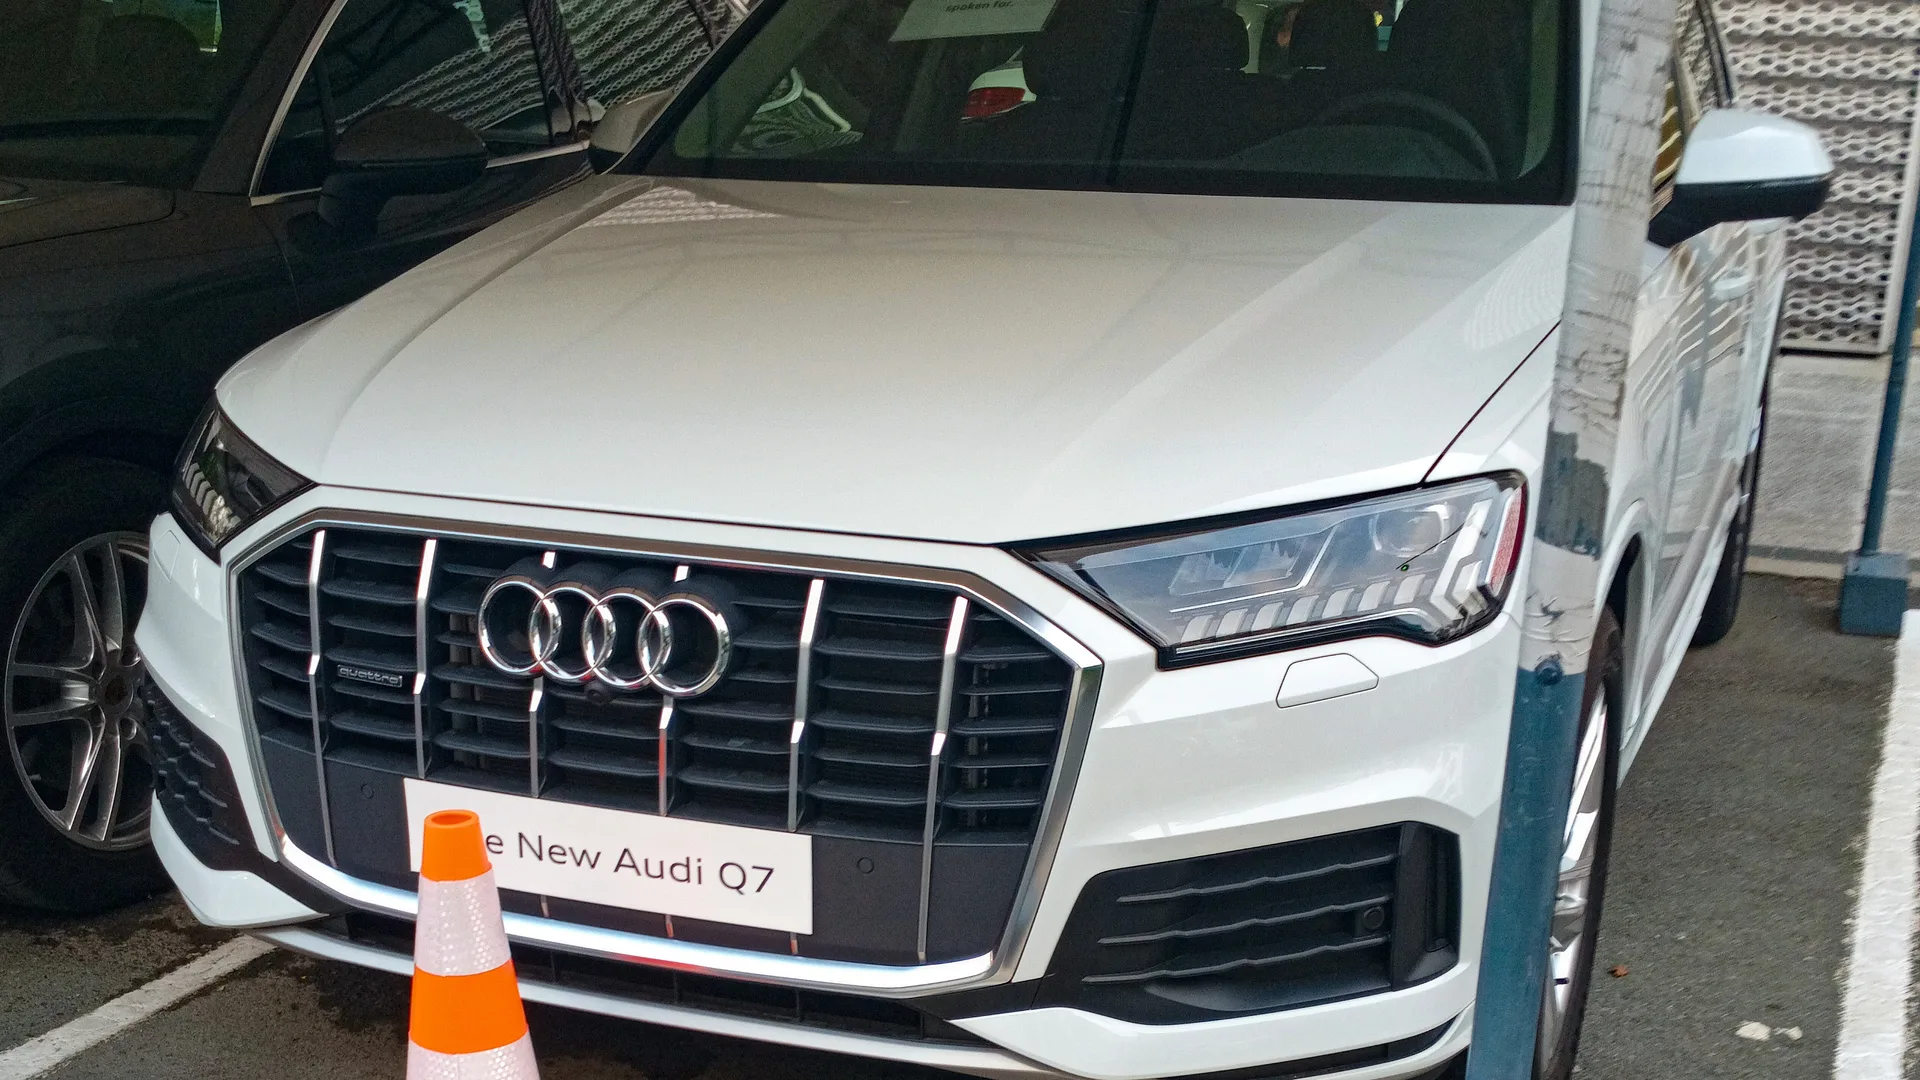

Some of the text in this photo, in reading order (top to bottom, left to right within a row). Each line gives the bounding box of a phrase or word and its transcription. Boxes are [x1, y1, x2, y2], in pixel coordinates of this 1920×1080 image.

[945, 2, 990, 12] spoken
[340, 668, 399, 684] quattro
[518, 832, 601, 869] New
[613, 848, 702, 885] Audi
[719, 861, 774, 895] Q7
